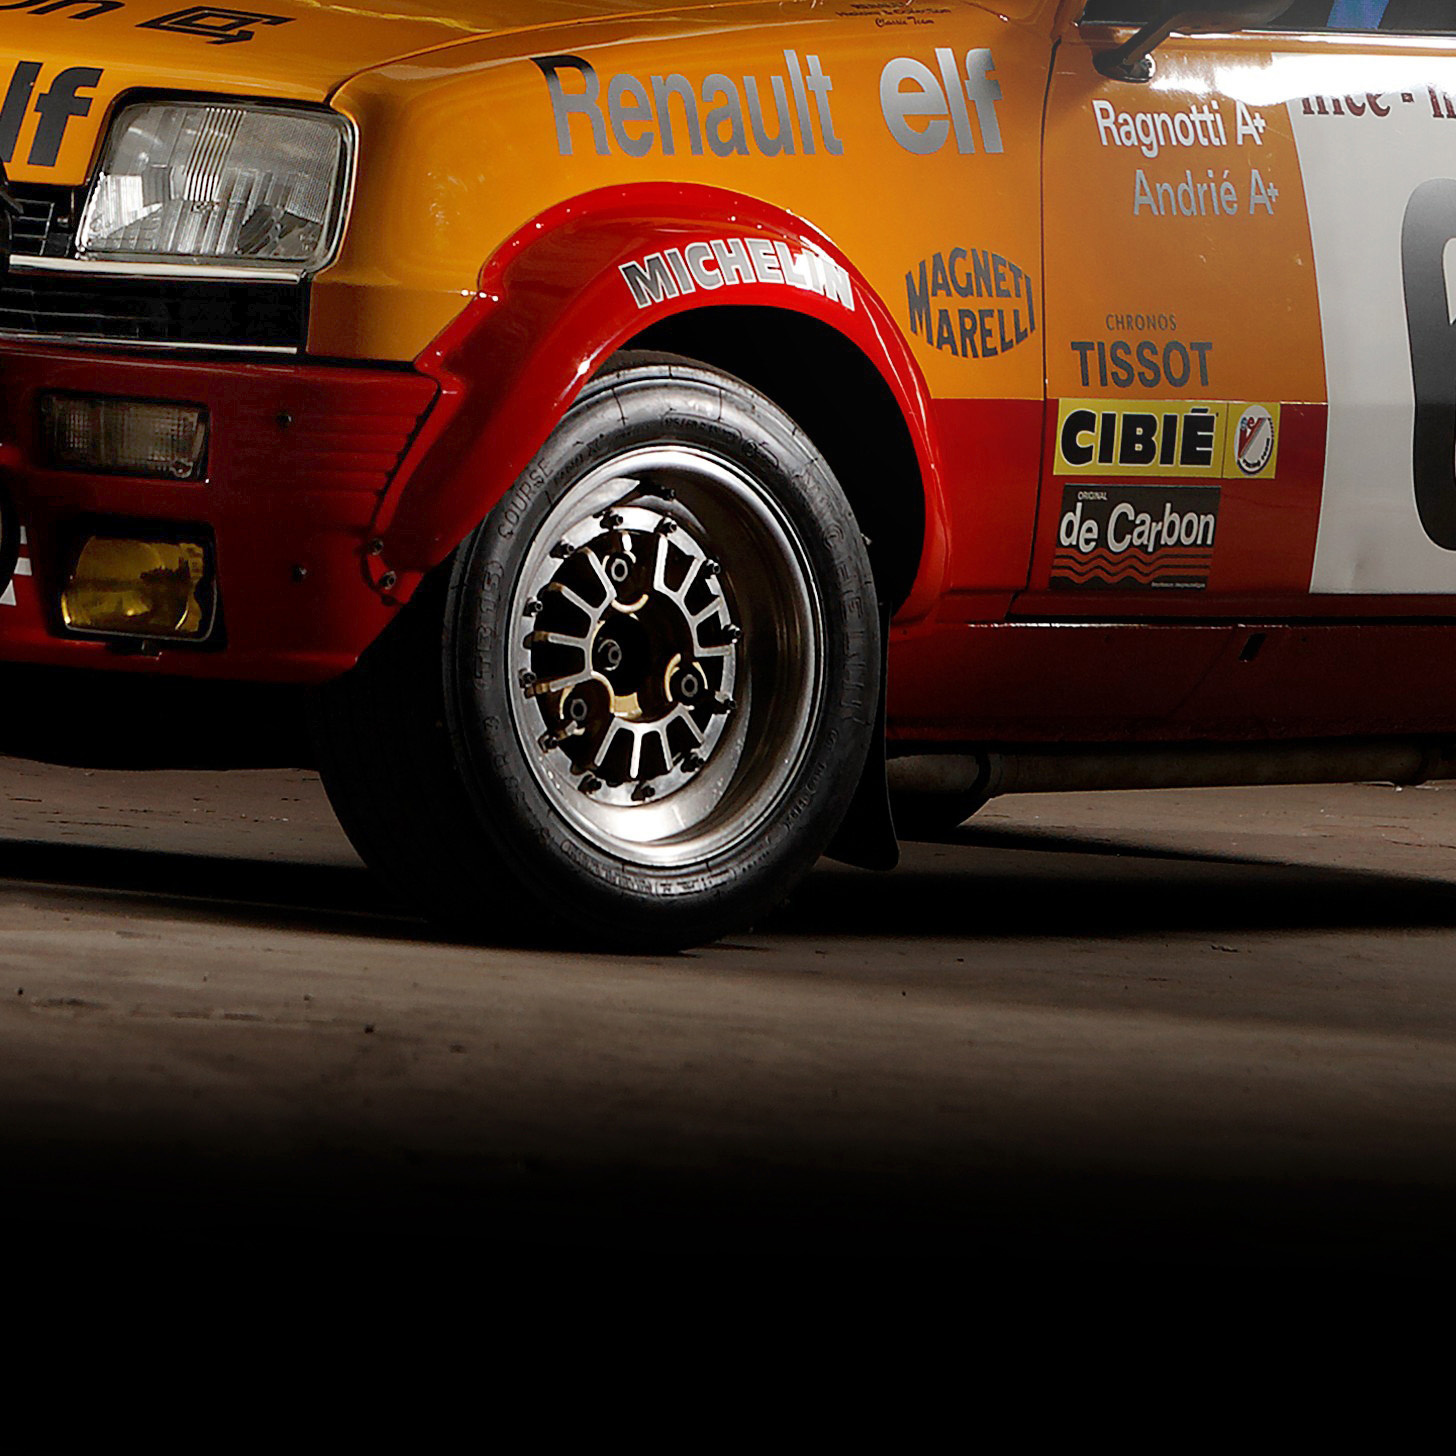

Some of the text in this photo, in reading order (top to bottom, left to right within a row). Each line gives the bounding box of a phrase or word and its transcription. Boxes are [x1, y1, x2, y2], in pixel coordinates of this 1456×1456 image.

[529, 47, 1004, 158] Renault elf
[1092, 99, 1267, 158] Ragnotti A+
[1133, 168, 1279, 216] Andrié A+
[618, 237, 856, 312] MICHELIN
[905, 247, 1035, 344] MAGNETI
[905, 271, 1036, 358] MARELLI
[1105, 313, 1177, 331] CHRONOS
[1070, 340, 1213, 388] TISSOT
[1060, 409, 1216, 467] CIBIÉ
[1077, 491, 1108, 501] ORIGINAL
[1059, 501, 1215, 553] de Carbon
